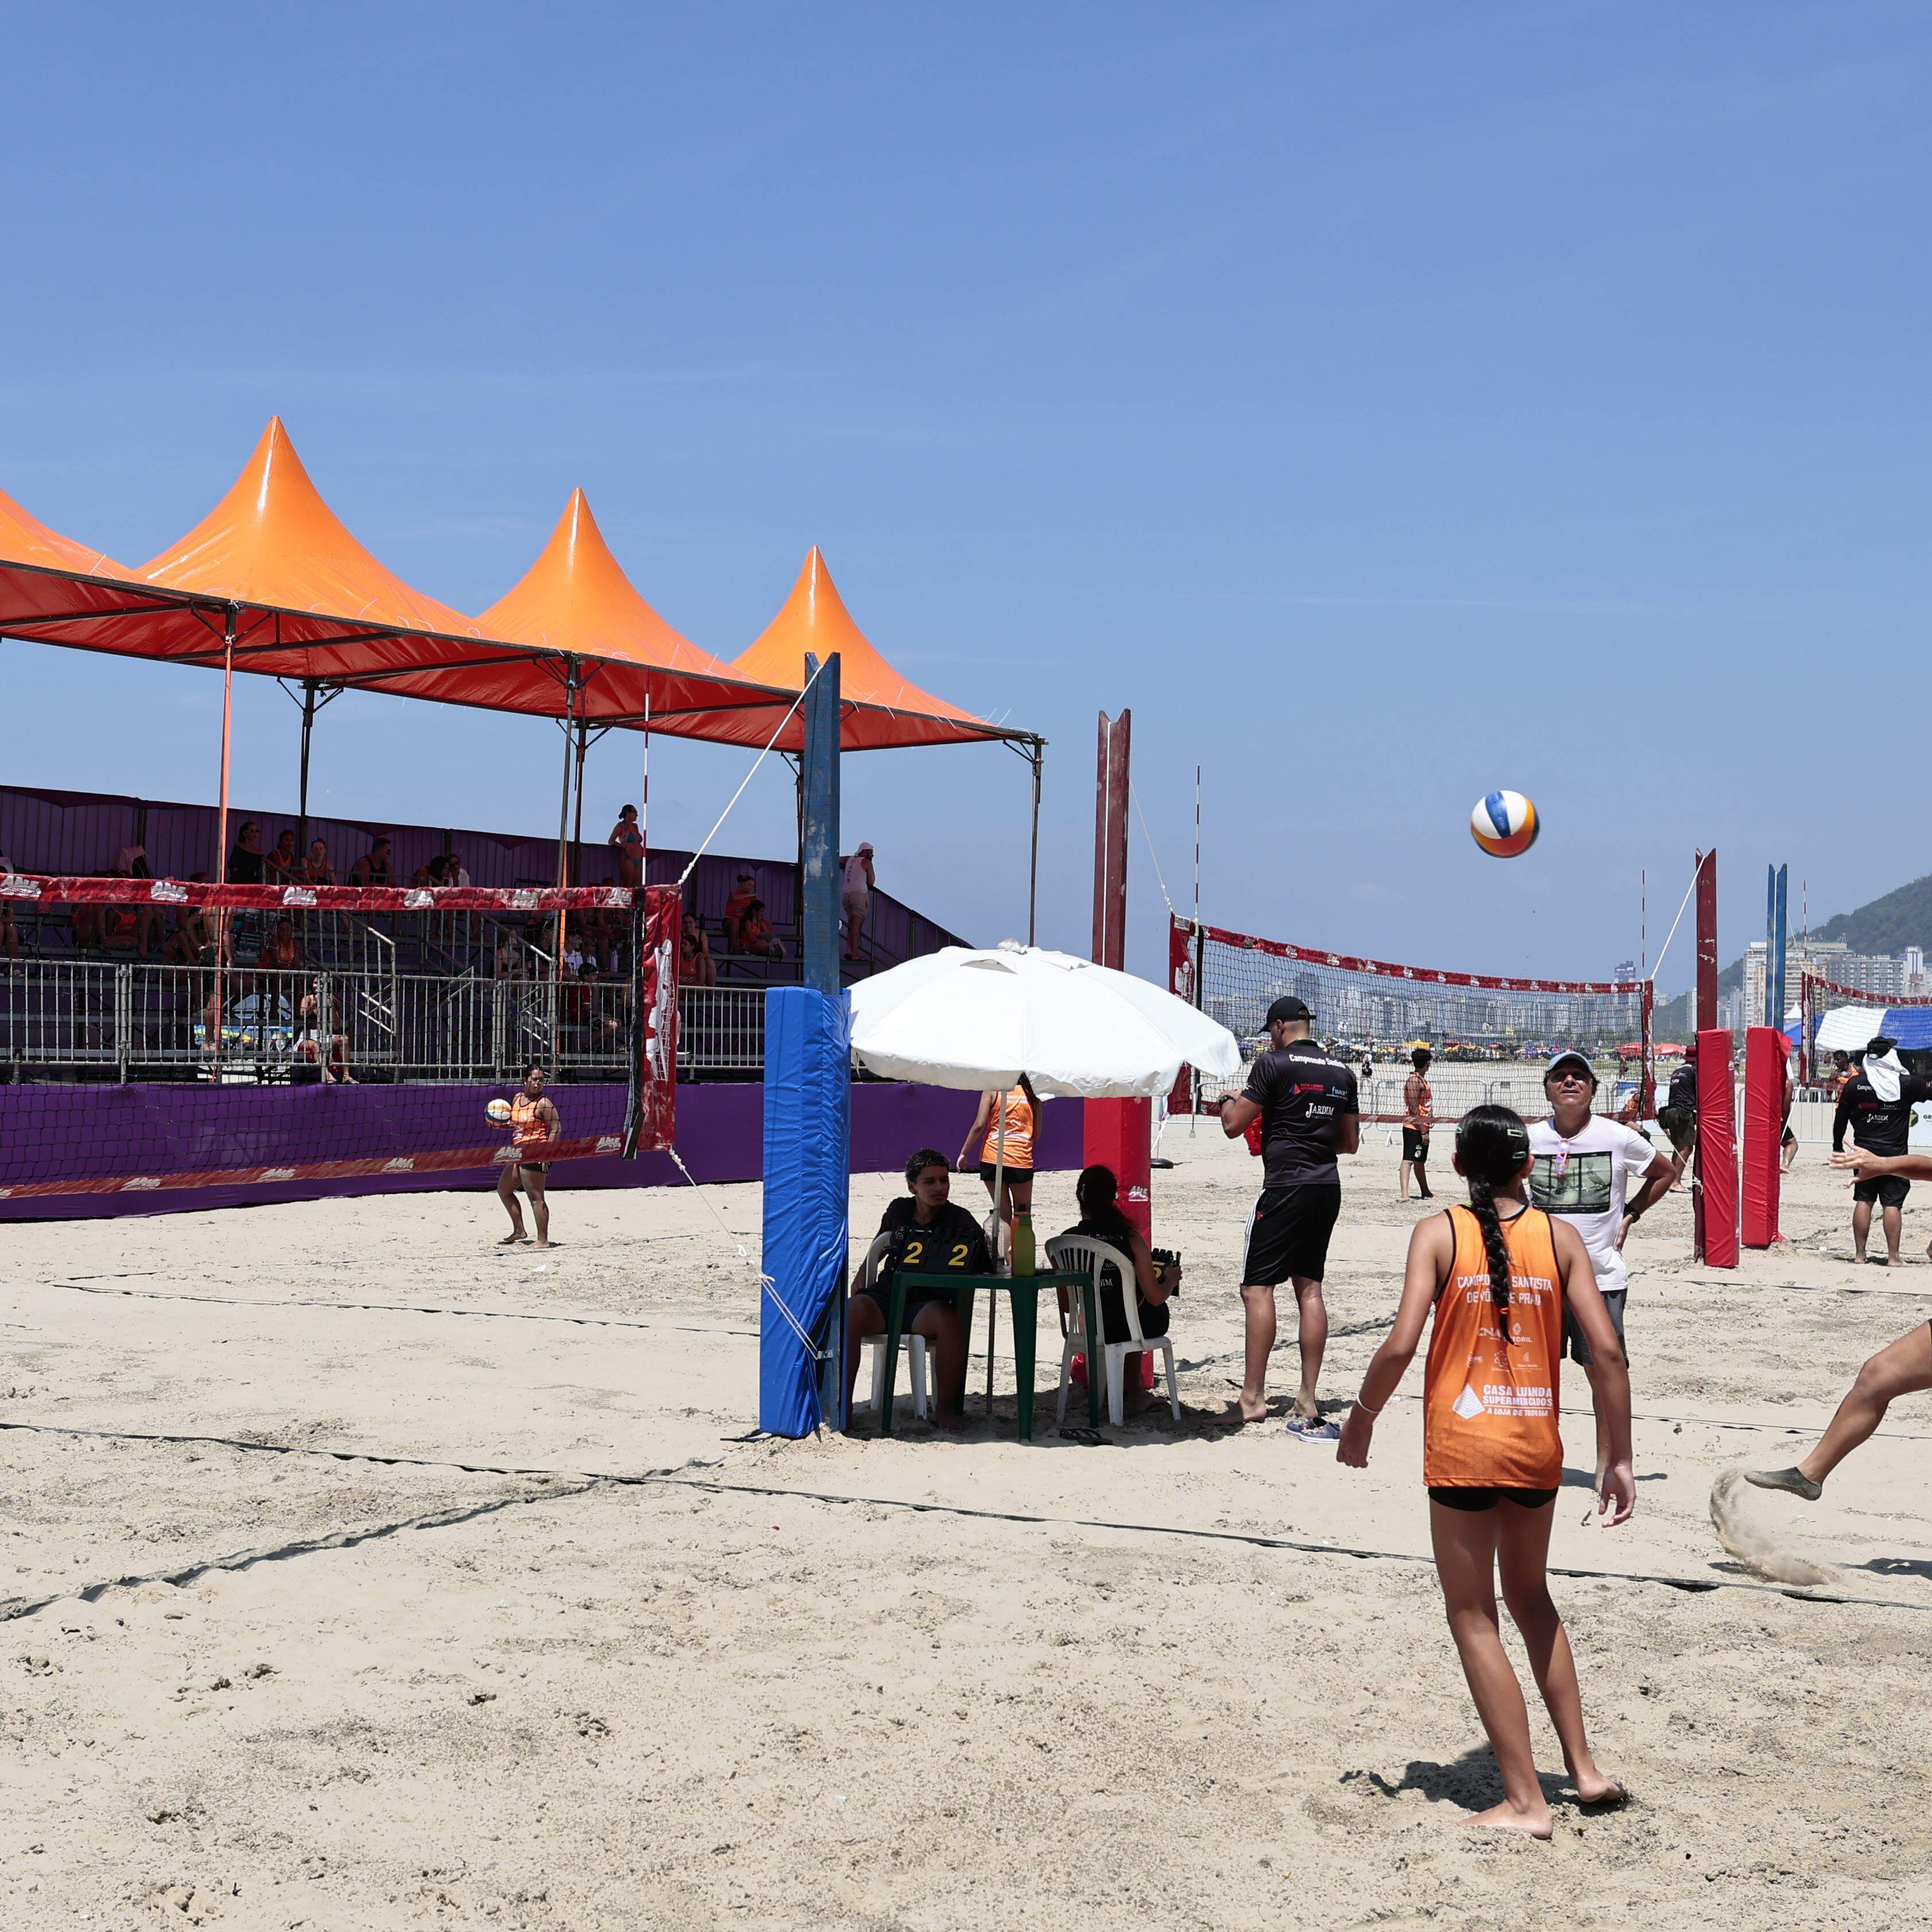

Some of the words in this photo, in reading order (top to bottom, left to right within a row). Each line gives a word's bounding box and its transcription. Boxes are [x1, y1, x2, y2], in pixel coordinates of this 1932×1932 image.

[1289, 1054, 1326, 1065] Campeonato
[1306, 1103, 1334, 1118] JARDIM
[903, 1242, 923, 1263] 2
[948, 1244, 968, 1266] 2
[1457, 1274, 1490, 1288] CAMPEO
[1512, 1276, 1553, 1291] SANTISTA
[1467, 1292, 1478, 1303] DE
[1509, 1292, 1515, 1303] E
[1483, 1384, 1513, 1396] CASA
